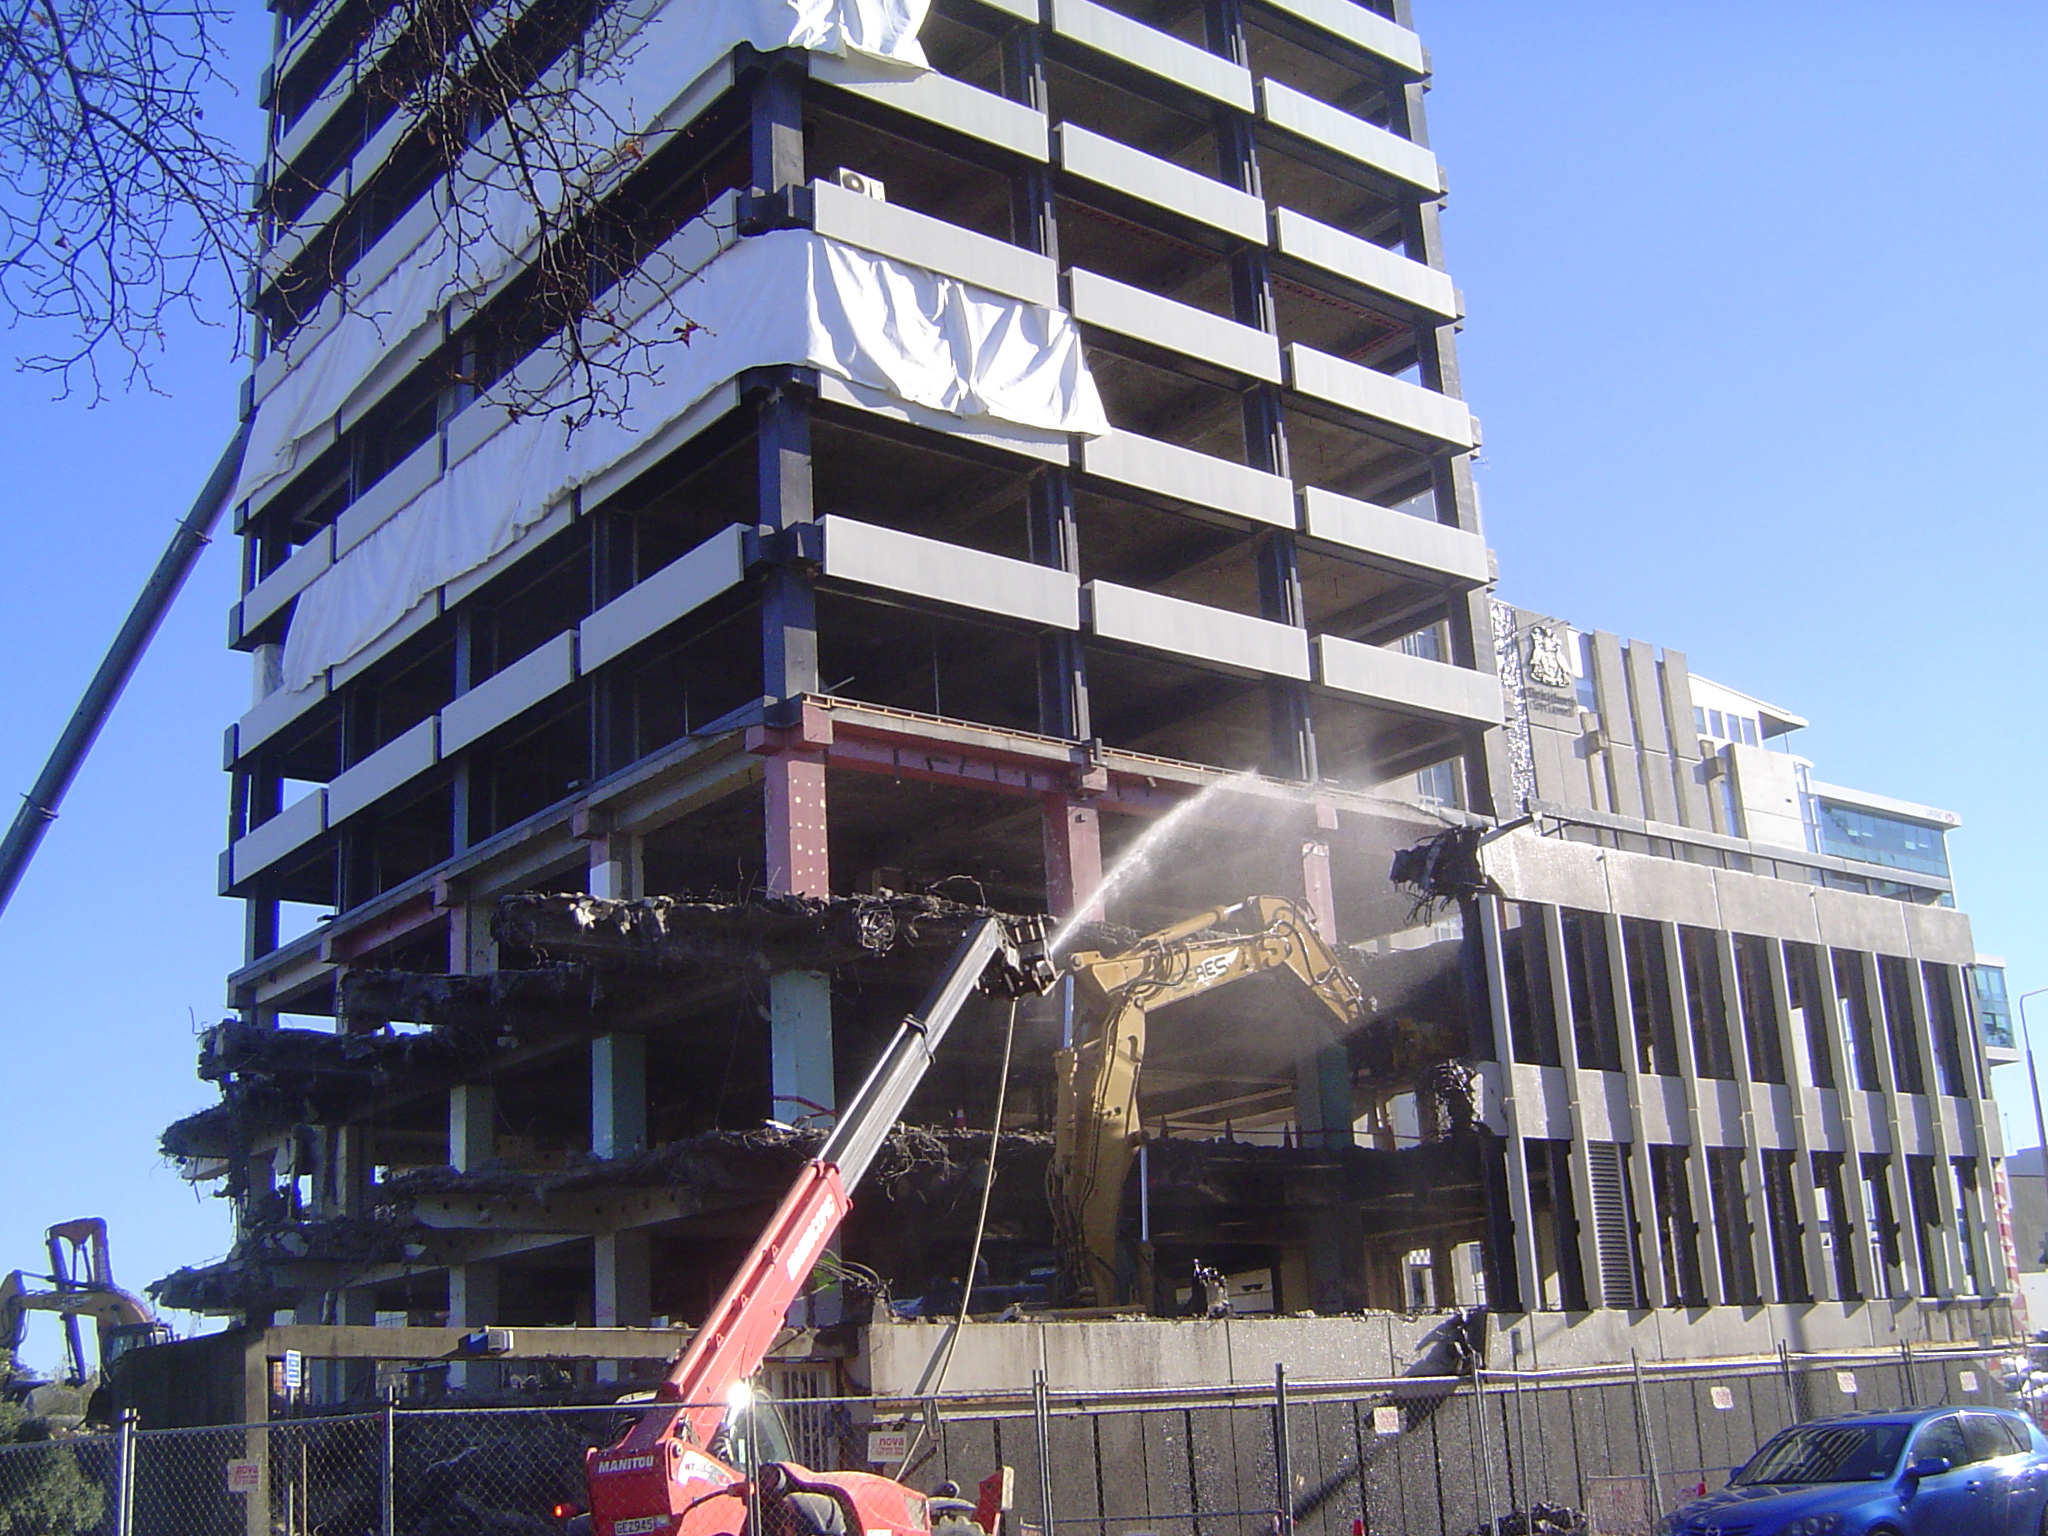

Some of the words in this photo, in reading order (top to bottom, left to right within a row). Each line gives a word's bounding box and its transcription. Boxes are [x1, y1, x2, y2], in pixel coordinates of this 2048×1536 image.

[879, 1437, 904, 1446] nova
[598, 1455, 654, 1474] MANITOU
[616, 1518, 653, 1534] GEZ945
